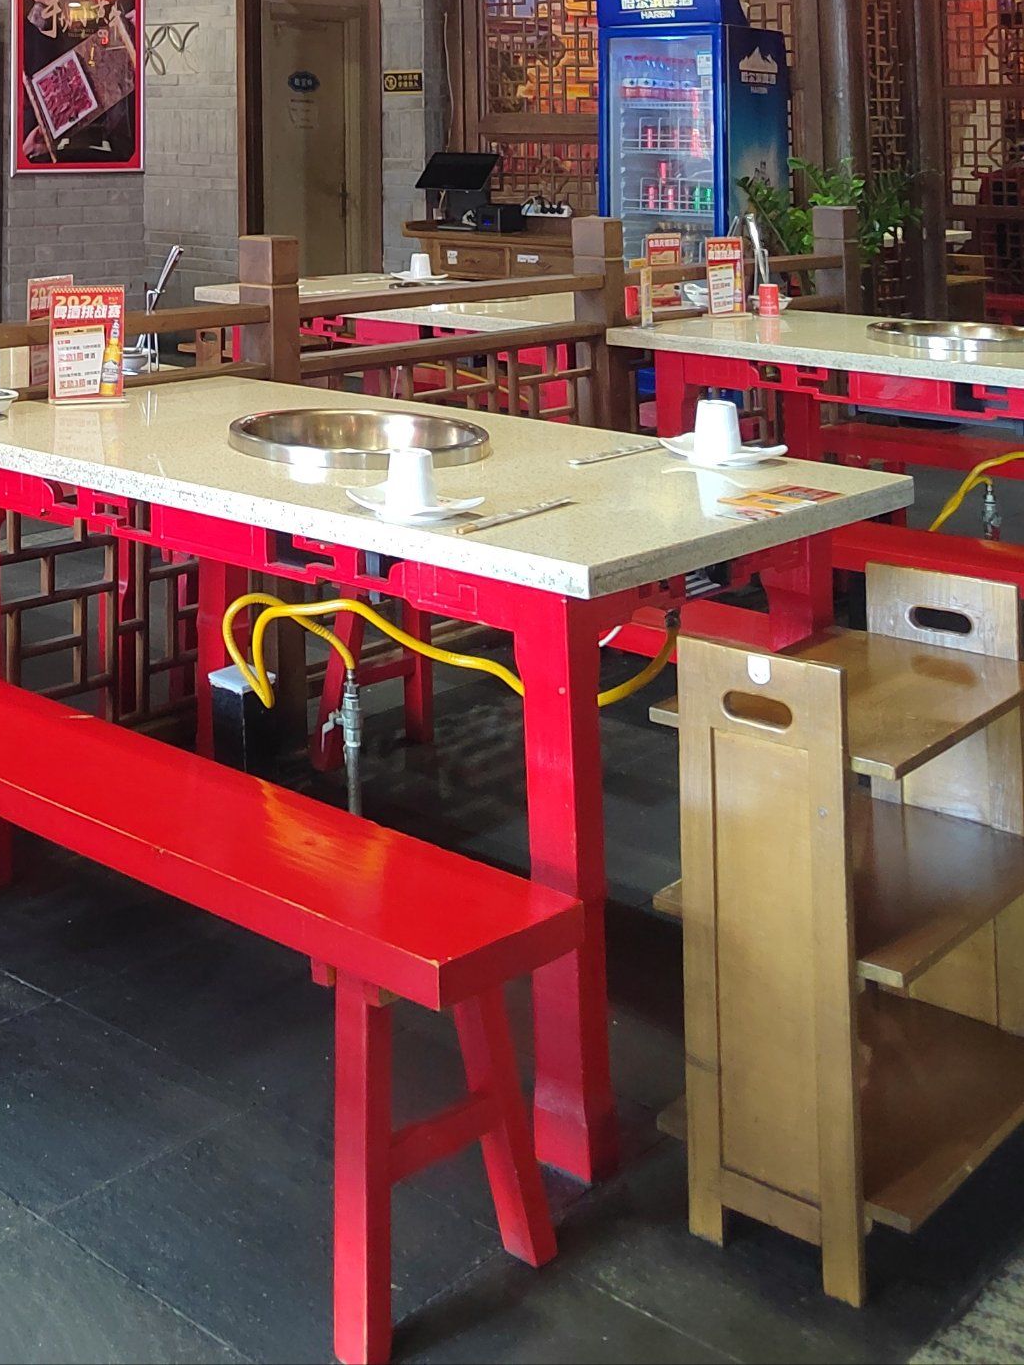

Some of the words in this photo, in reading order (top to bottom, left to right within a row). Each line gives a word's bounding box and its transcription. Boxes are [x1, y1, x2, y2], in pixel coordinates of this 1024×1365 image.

[640, 10, 675, 20] HARBIN
[56, 295, 103, 307] 2024
[54, 305, 121, 319] 啤酒挑战赛
